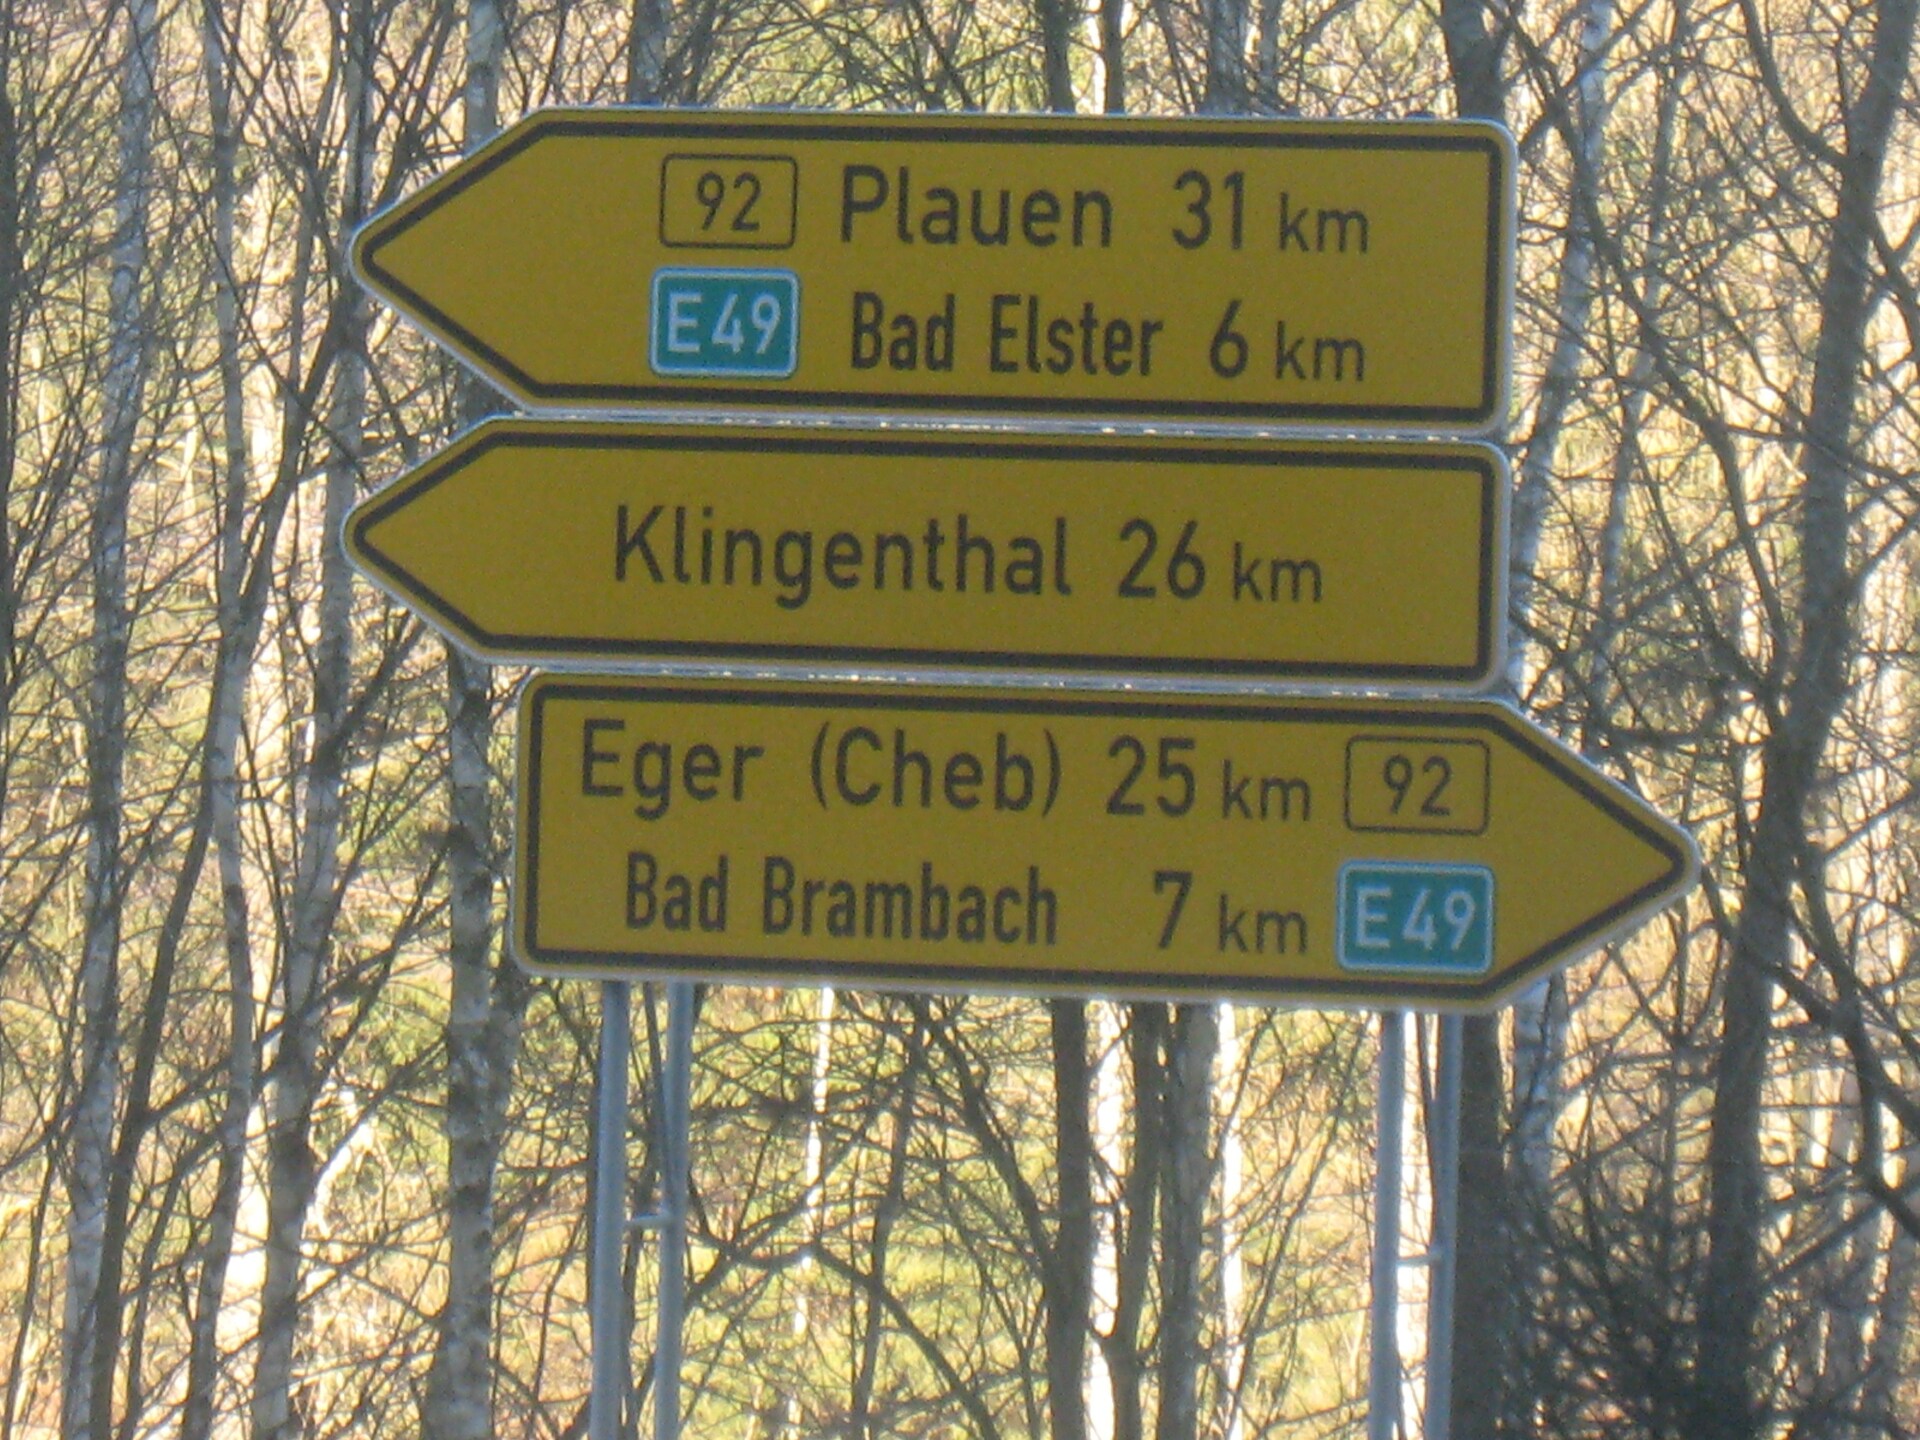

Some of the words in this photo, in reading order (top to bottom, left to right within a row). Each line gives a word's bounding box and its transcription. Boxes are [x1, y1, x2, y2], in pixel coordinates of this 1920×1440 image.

[695, 172, 762, 232] 92
[840, 164, 1114, 248] Plauen
[1171, 170, 1245, 251] 31
[1278, 191, 1369, 254] km
[668, 292, 703, 354] E
[711, 293, 782, 355] 49
[850, 291, 956, 372] Bad
[989, 293, 1164, 377] Elster
[1209, 299, 1249, 379] 6
[1275, 319, 1365, 383] km
[615, 504, 1072, 609] Klingenthal
[1117, 517, 1205, 600] 26
[1232, 541, 1323, 603] km
[581, 719, 765, 818] Eger
[810, 721, 1062, 818] (Cheb)
[1106, 736, 1196, 818] 25
[1221, 758, 1312, 822] km
[1382, 754, 1453, 817] 92
[625, 850, 729, 931] Bad
[762, 855, 1058, 946] Brambach
[1153, 869, 1193, 950] 7
[1218, 892, 1308, 955] km
[1355, 887, 1393, 950] E
[1401, 888, 1477, 952] 49
